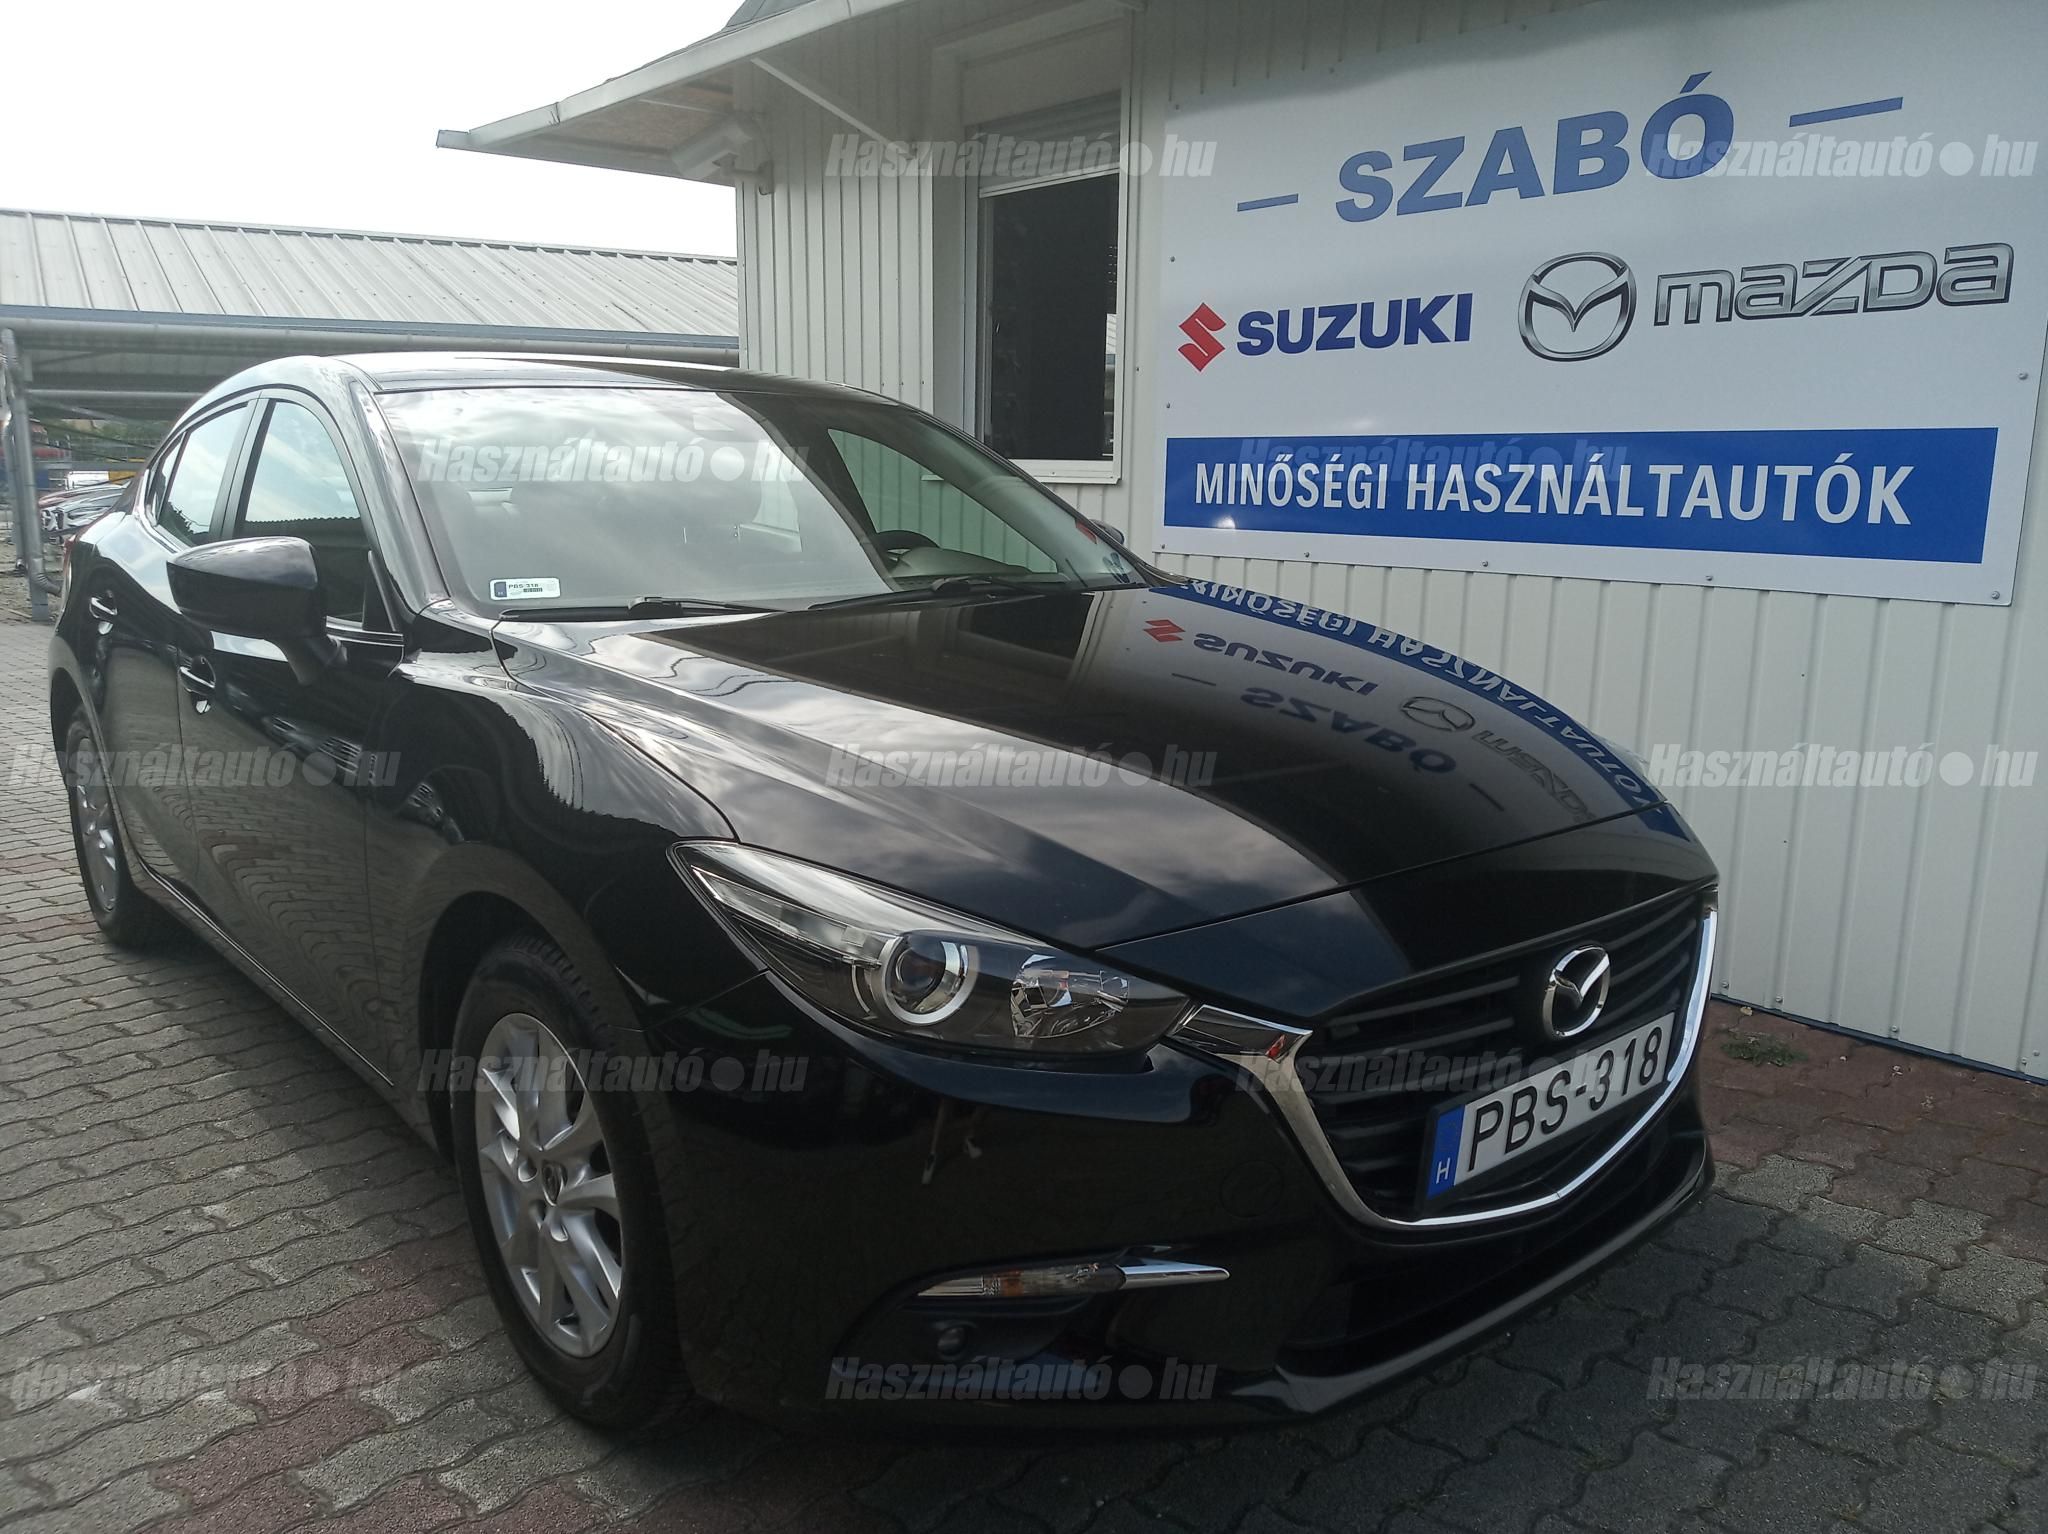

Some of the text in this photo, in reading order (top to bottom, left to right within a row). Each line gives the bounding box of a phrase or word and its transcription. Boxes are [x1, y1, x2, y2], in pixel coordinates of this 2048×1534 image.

[1335, 72, 1734, 222] SZABÓ
[1237, 293, 1473, 356] SUZUKI
[1194, 452, 1915, 525] MINŐSÉGI HASZNÁLTAUTÓK
[1468, 1026, 1663, 1173] PBS-318
